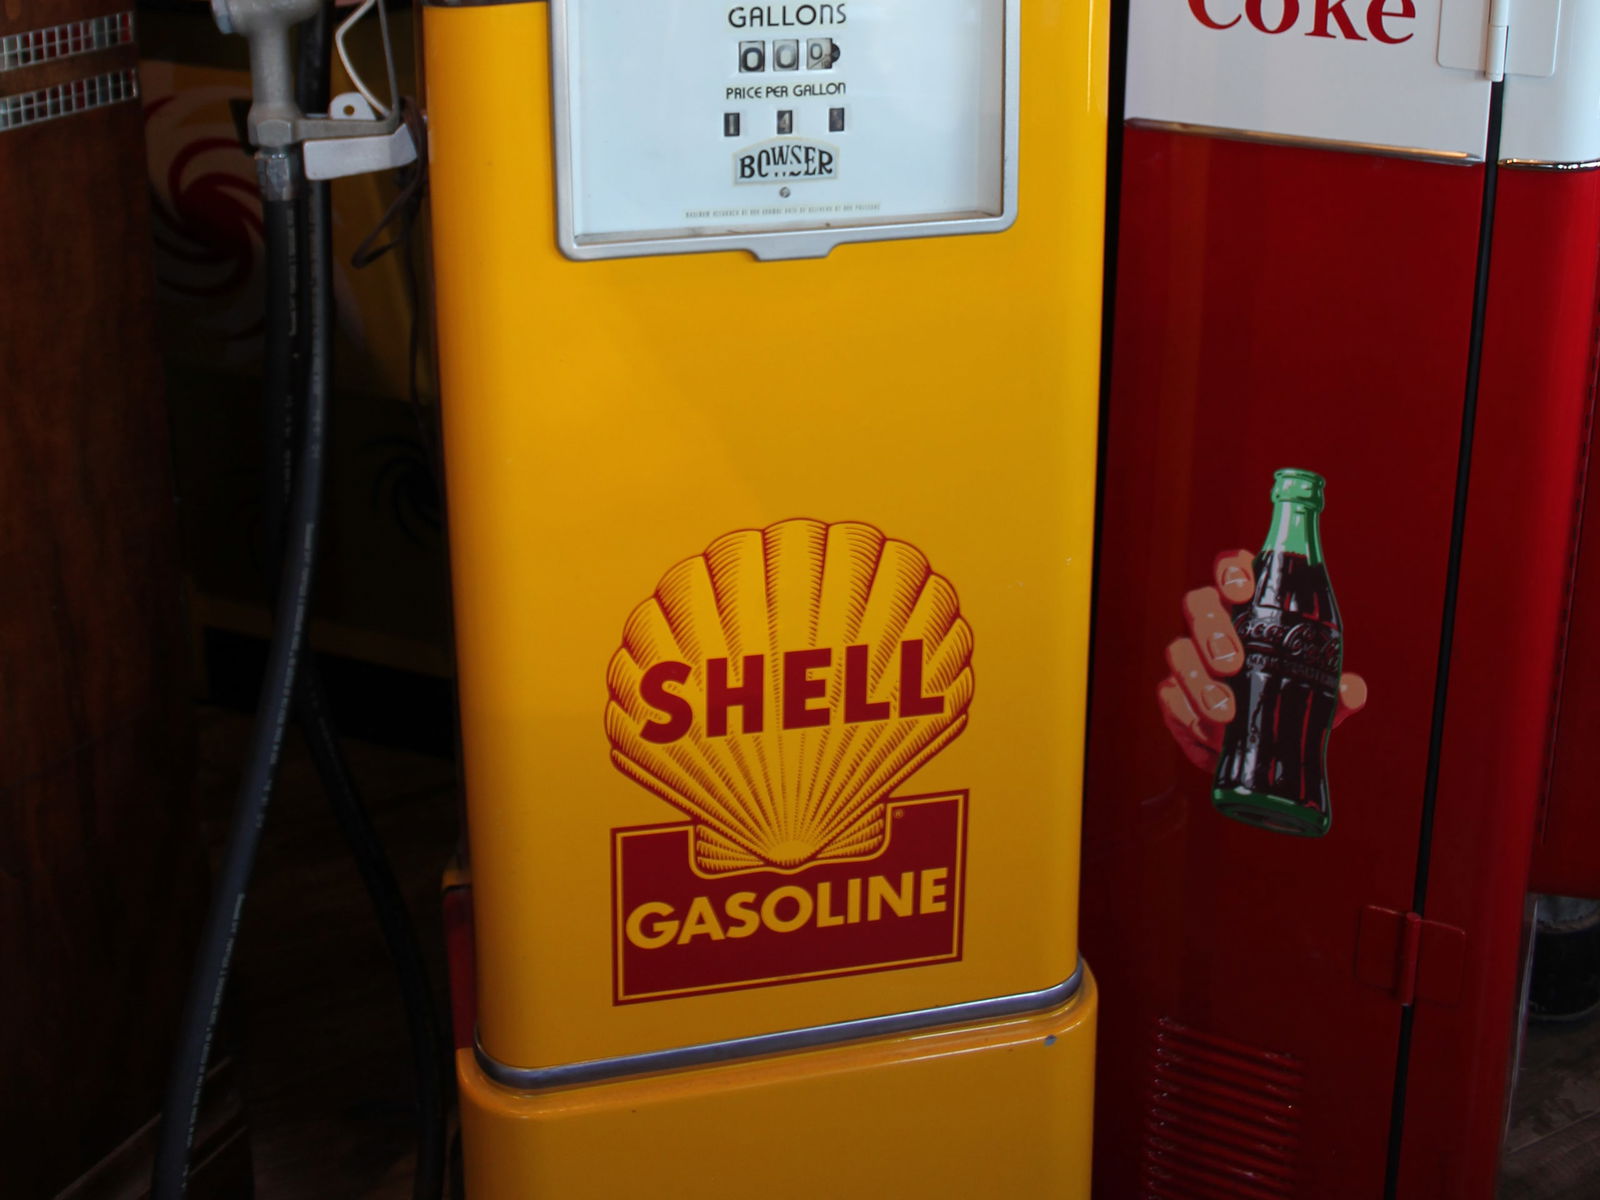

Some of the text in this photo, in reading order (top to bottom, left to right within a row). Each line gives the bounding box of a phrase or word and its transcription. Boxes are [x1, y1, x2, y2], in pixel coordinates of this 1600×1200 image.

[728, 3, 847, 28] GALLONS
[726, 82, 846, 100] PRICE PER GALLON
[739, 144, 833, 179] BOWSER
[638, 638, 945, 745] SHELL
[625, 867, 949, 950] GASOLINE
